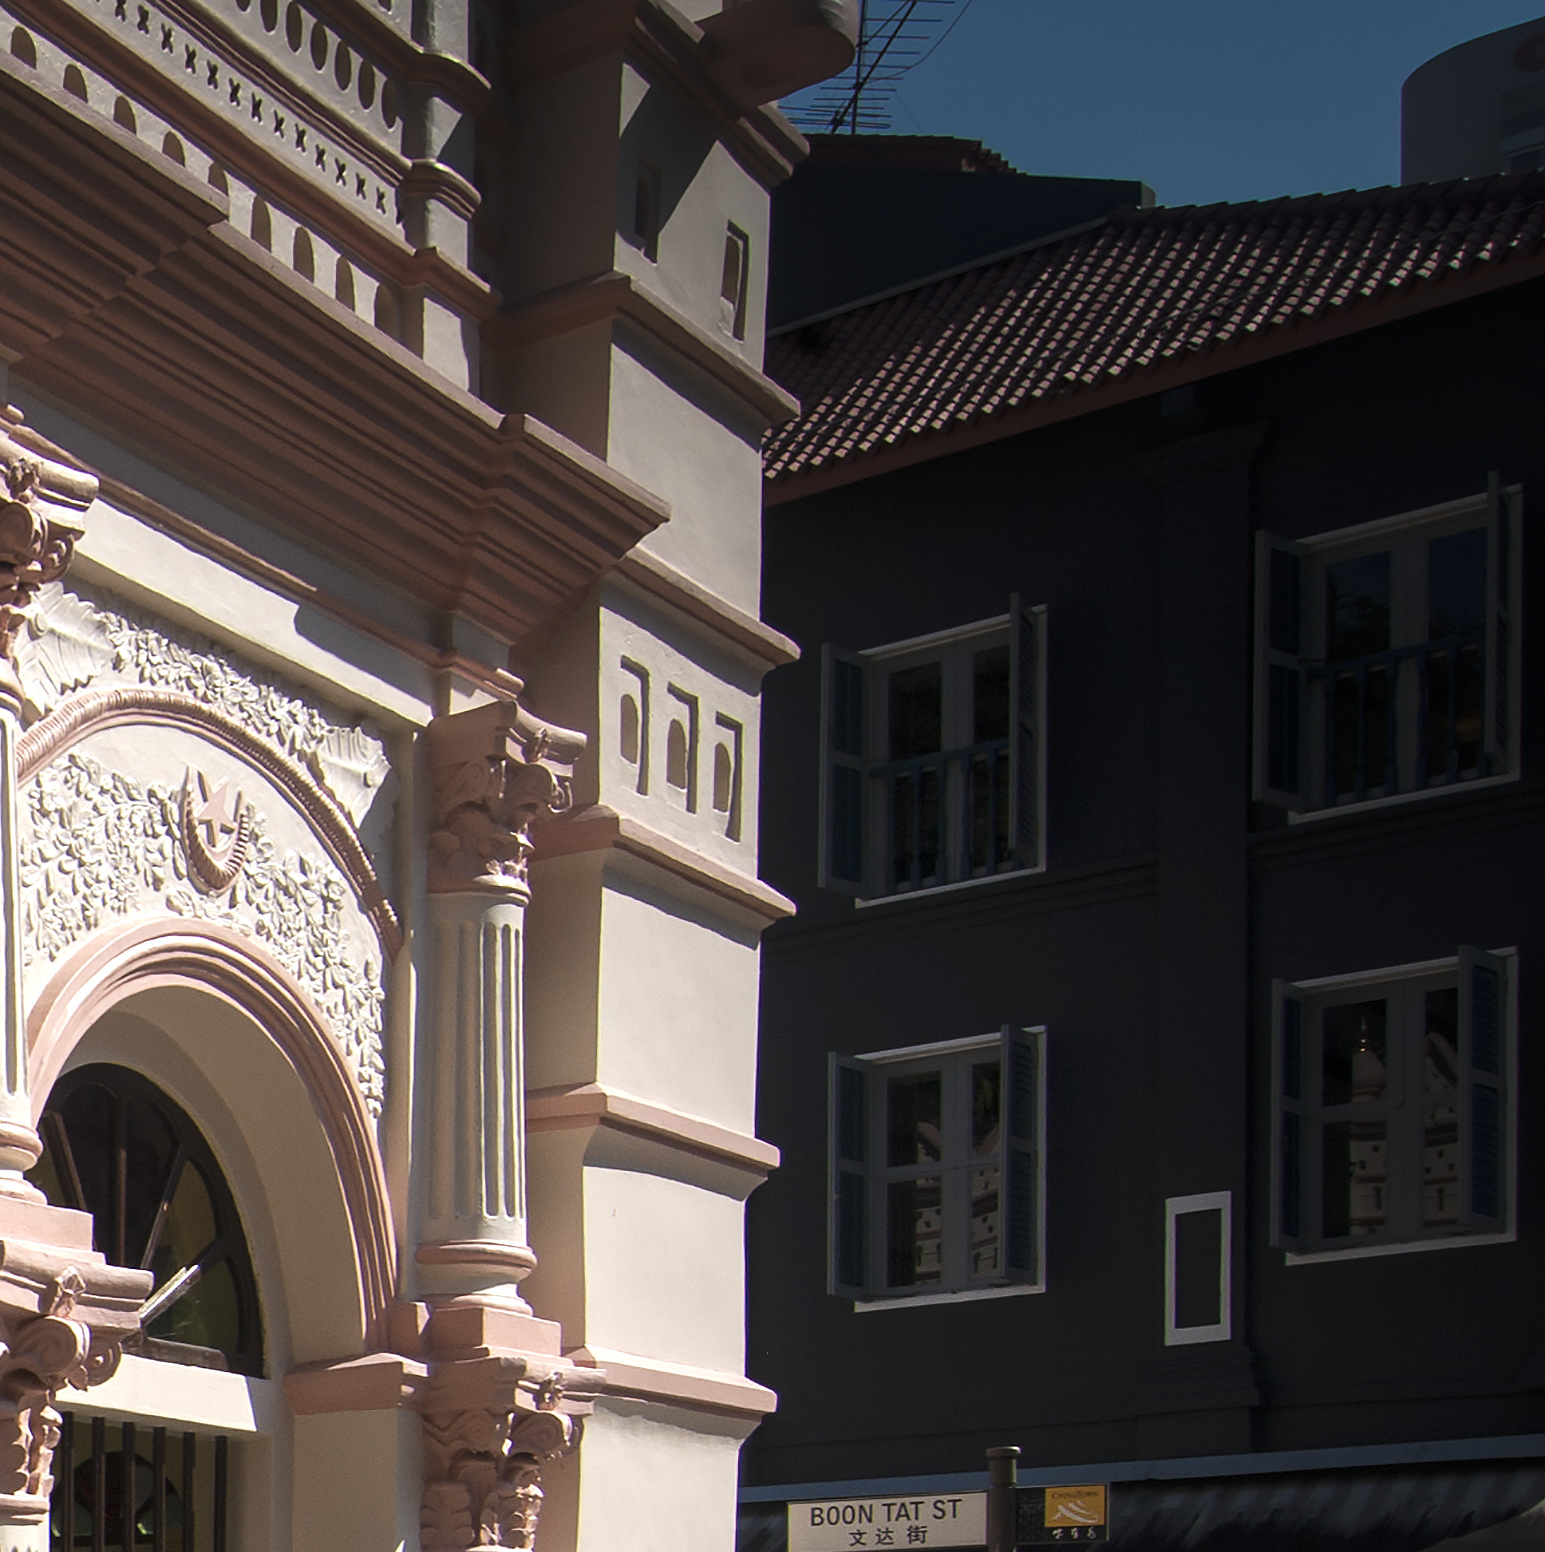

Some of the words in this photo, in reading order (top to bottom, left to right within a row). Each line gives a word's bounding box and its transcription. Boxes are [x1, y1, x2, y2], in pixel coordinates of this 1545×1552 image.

[811, 1504, 873, 1526] BOON
[882, 1501, 924, 1522] TAT
[932, 1499, 962, 1520] ST
[849, 1525, 928, 1546] 文达街
